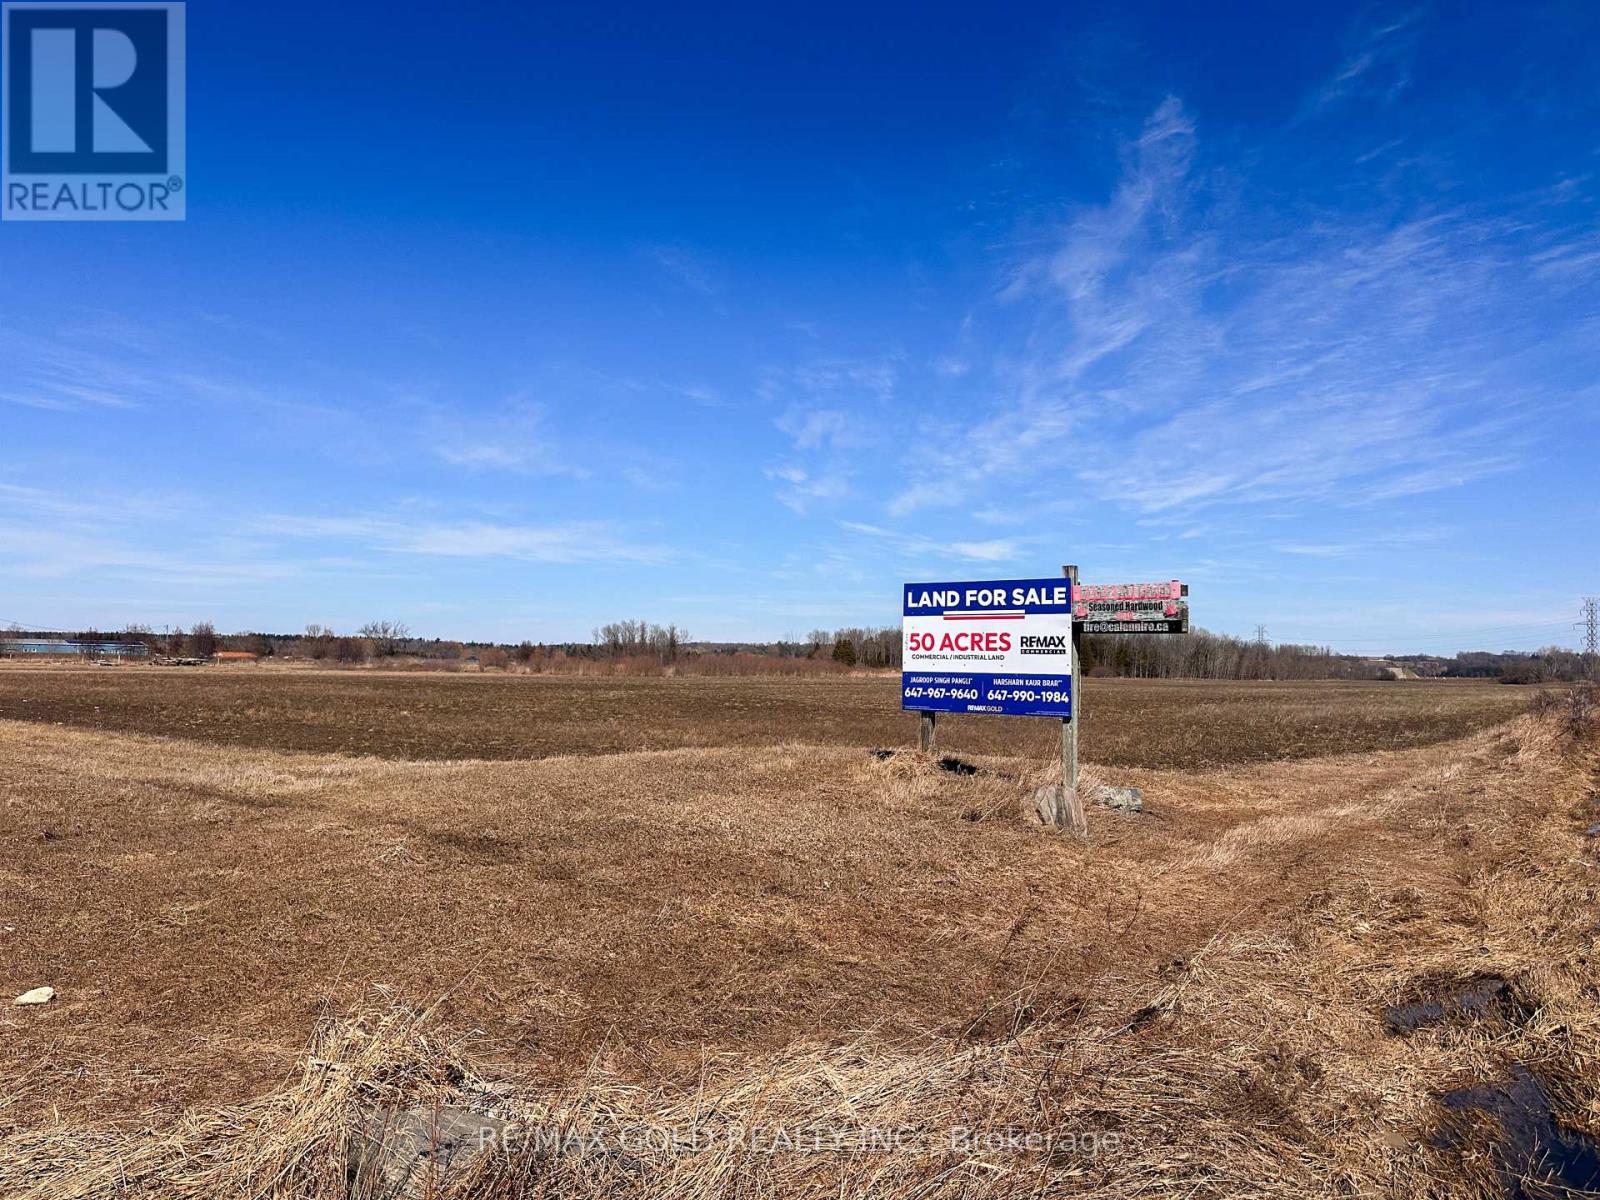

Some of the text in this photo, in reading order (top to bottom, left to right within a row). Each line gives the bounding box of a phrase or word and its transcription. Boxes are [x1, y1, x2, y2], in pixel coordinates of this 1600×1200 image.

[907, 591, 960, 607] LAND
[966, 589, 1006, 606] FOR
[1012, 587, 1067, 605] SALE
[1088, 601, 1163, 612] Seasoned Hardwood
[909, 633, 935, 652] 50
[939, 632, 1011, 652] ACRES
[905, 688, 978, 699] 647-967-9640
[987, 690, 1069, 703] 647-990-1984
